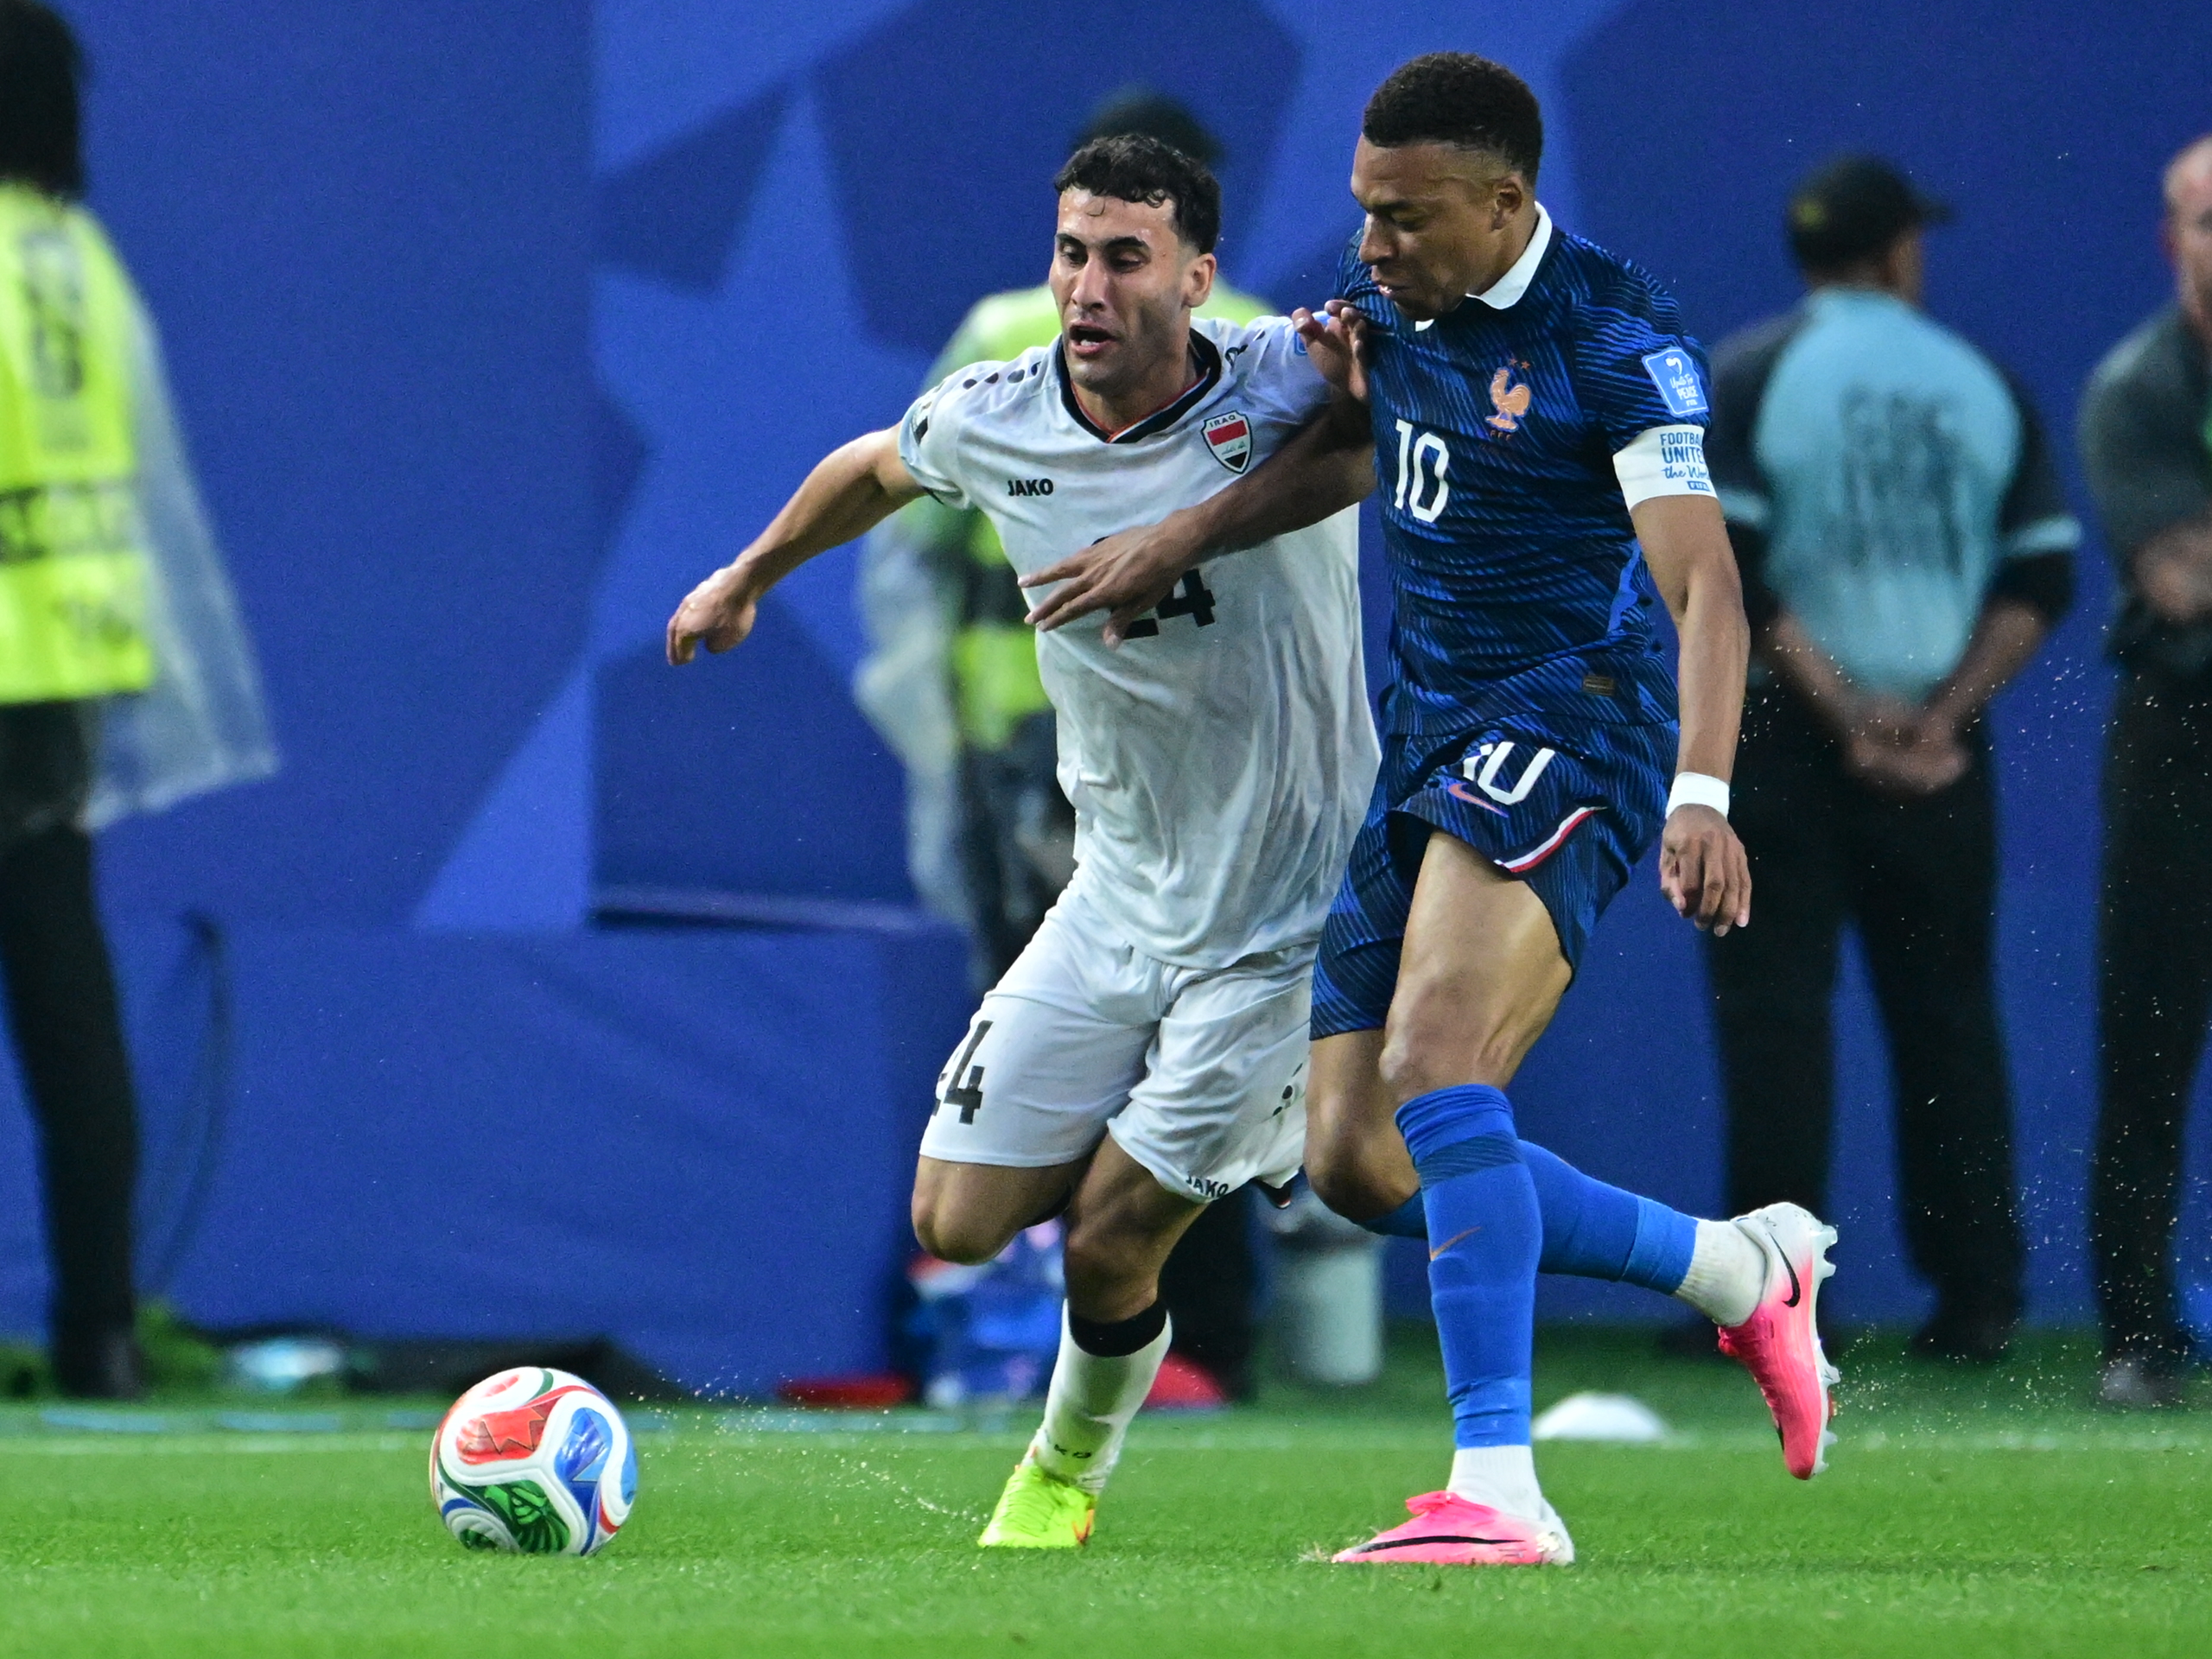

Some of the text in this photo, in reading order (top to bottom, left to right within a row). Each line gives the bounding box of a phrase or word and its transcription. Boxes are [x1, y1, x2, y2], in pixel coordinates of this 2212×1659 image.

[1210, 415, 1236, 428] IRAQ
[1395, 419, 1449, 523] 10
[1661, 466, 1686, 479] the
[1007, 478, 1054, 497] JAKO
[932, 1020, 994, 1126] 4
